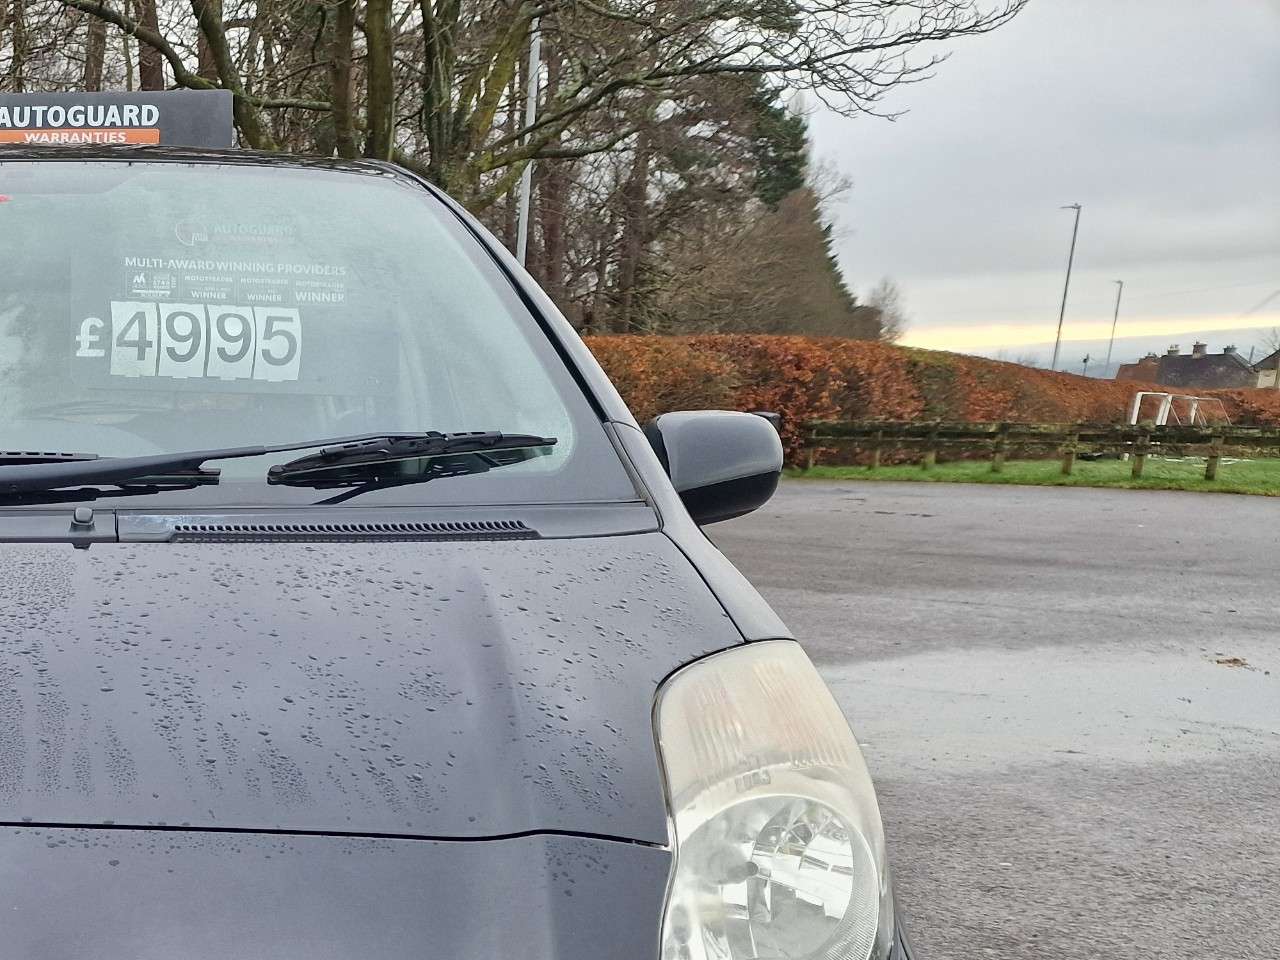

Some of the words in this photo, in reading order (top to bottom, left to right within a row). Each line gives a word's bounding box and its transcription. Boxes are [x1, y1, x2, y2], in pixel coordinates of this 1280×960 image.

[24, 131, 127, 144] WARRANTIES
[124, 256, 215, 271] MULTI-AWARD
[217, 261, 274, 274] WINNING
[277, 262, 347, 276] PROVIDERS
[191, 290, 227, 299] WINNER
[247, 293, 282, 303] WINNER
[295, 291, 345, 303] WINNER
[75, 310, 298, 367] £4995
